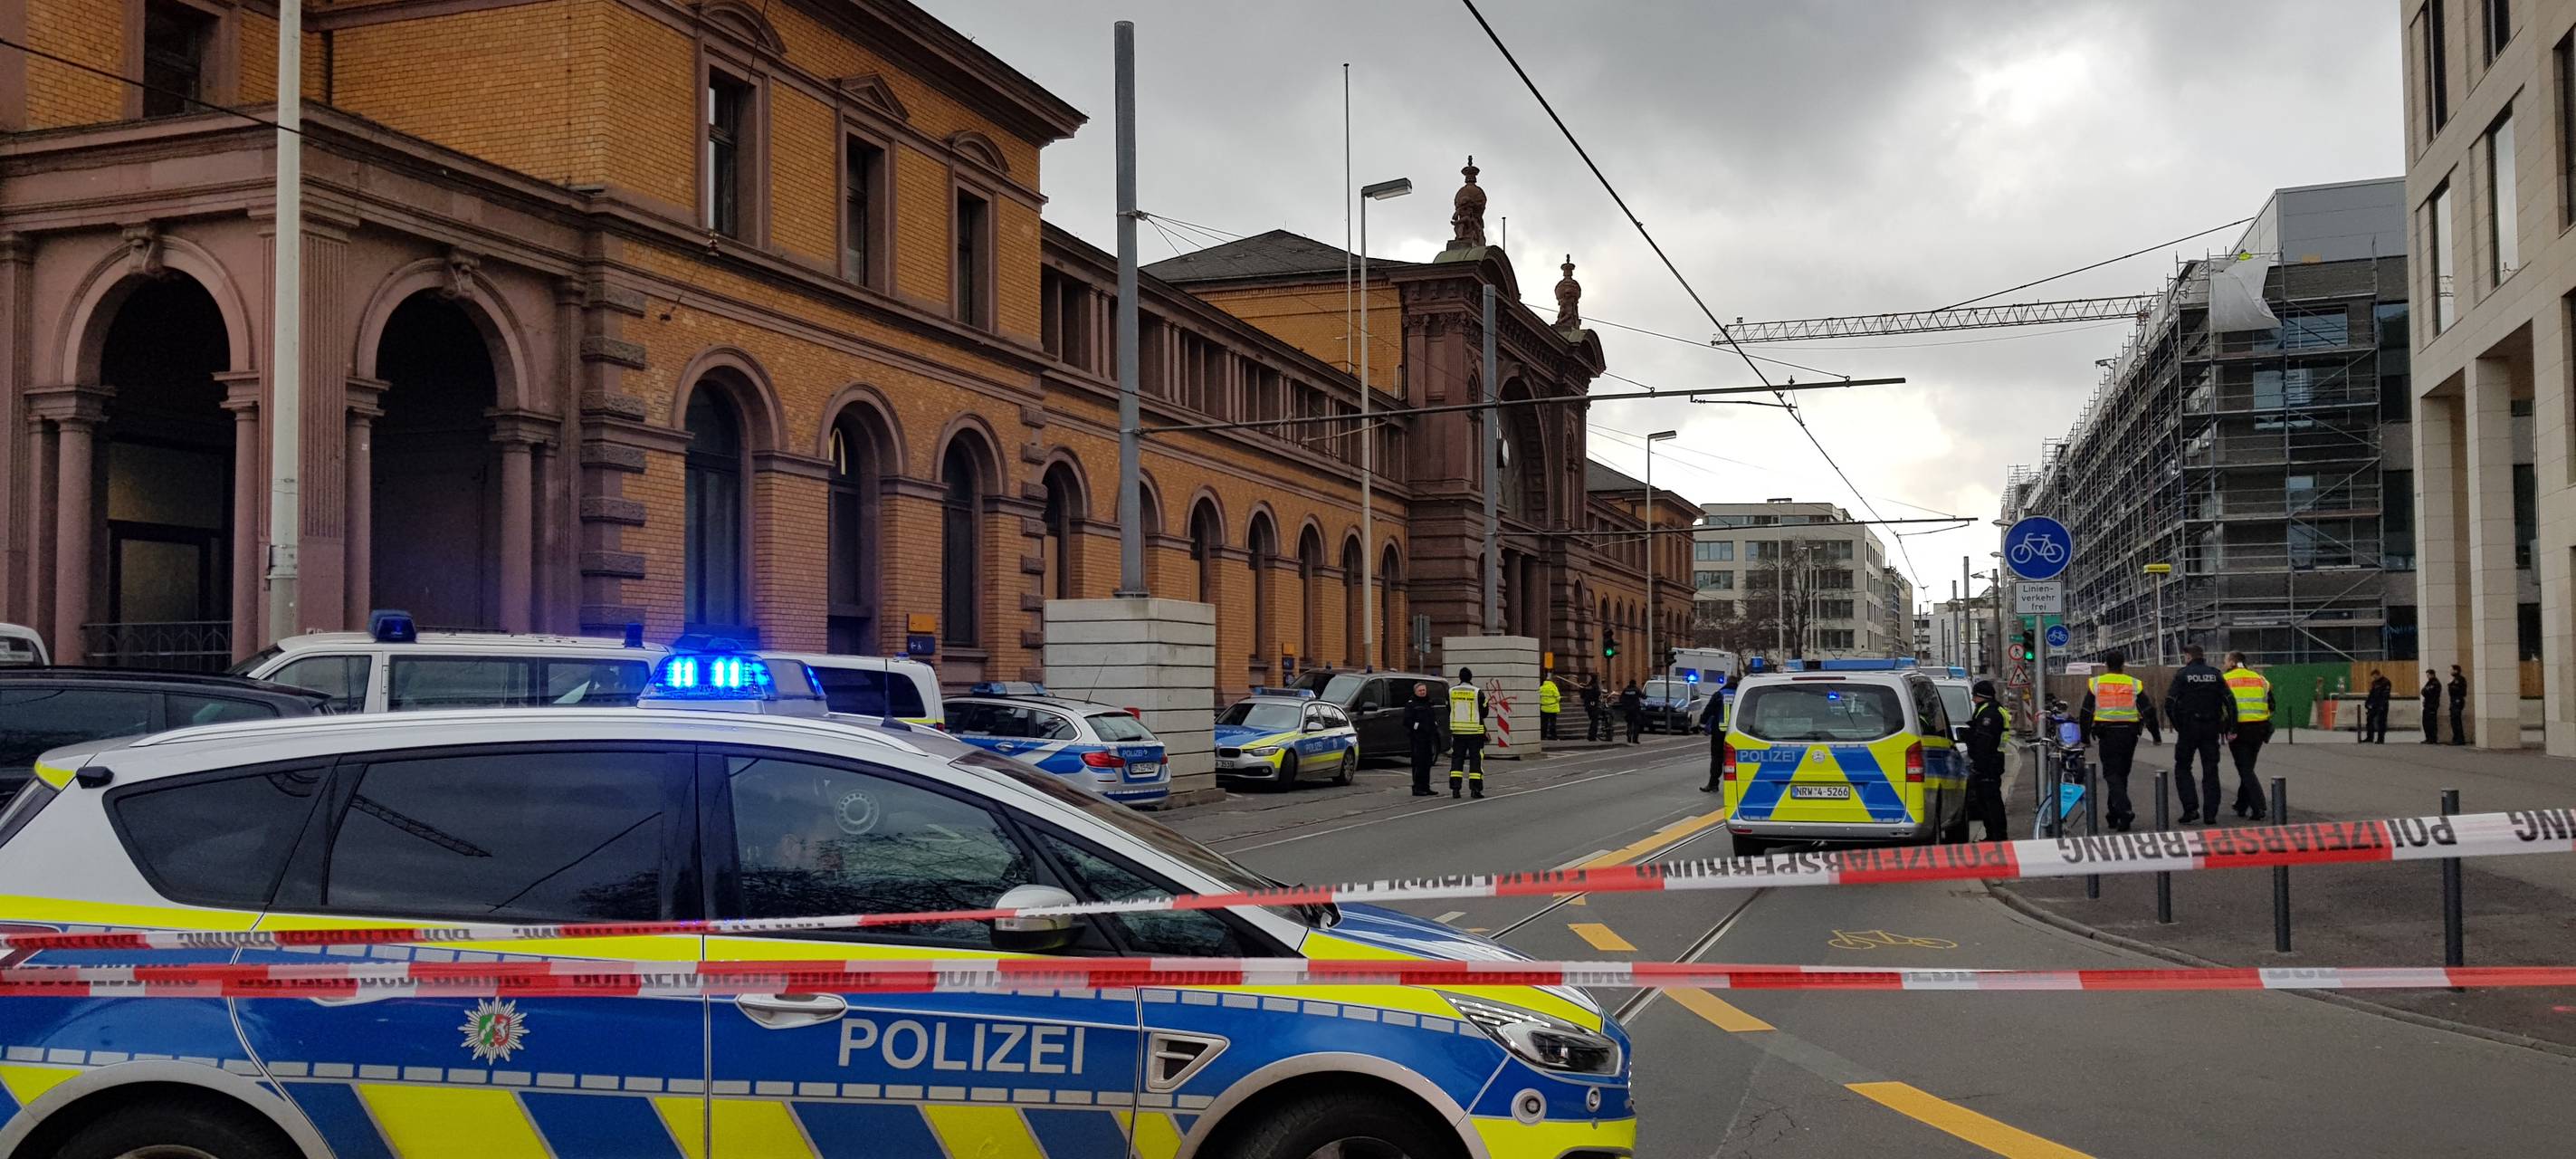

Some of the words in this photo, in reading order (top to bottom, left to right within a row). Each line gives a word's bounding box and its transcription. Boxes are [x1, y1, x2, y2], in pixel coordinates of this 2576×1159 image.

[2023, 584, 2054, 593] Linien-
[2021, 594, 2056, 602] verkehr
[2031, 602, 2047, 611] frei
[2187, 675, 2217, 683] POLIZEI
[1121, 749, 1143, 757] POLIZEI
[1740, 751, 1795, 762] POLIZEI
[1796, 787, 1814, 797] NRW
[838, 1017, 1085, 1075] POLIZEI
